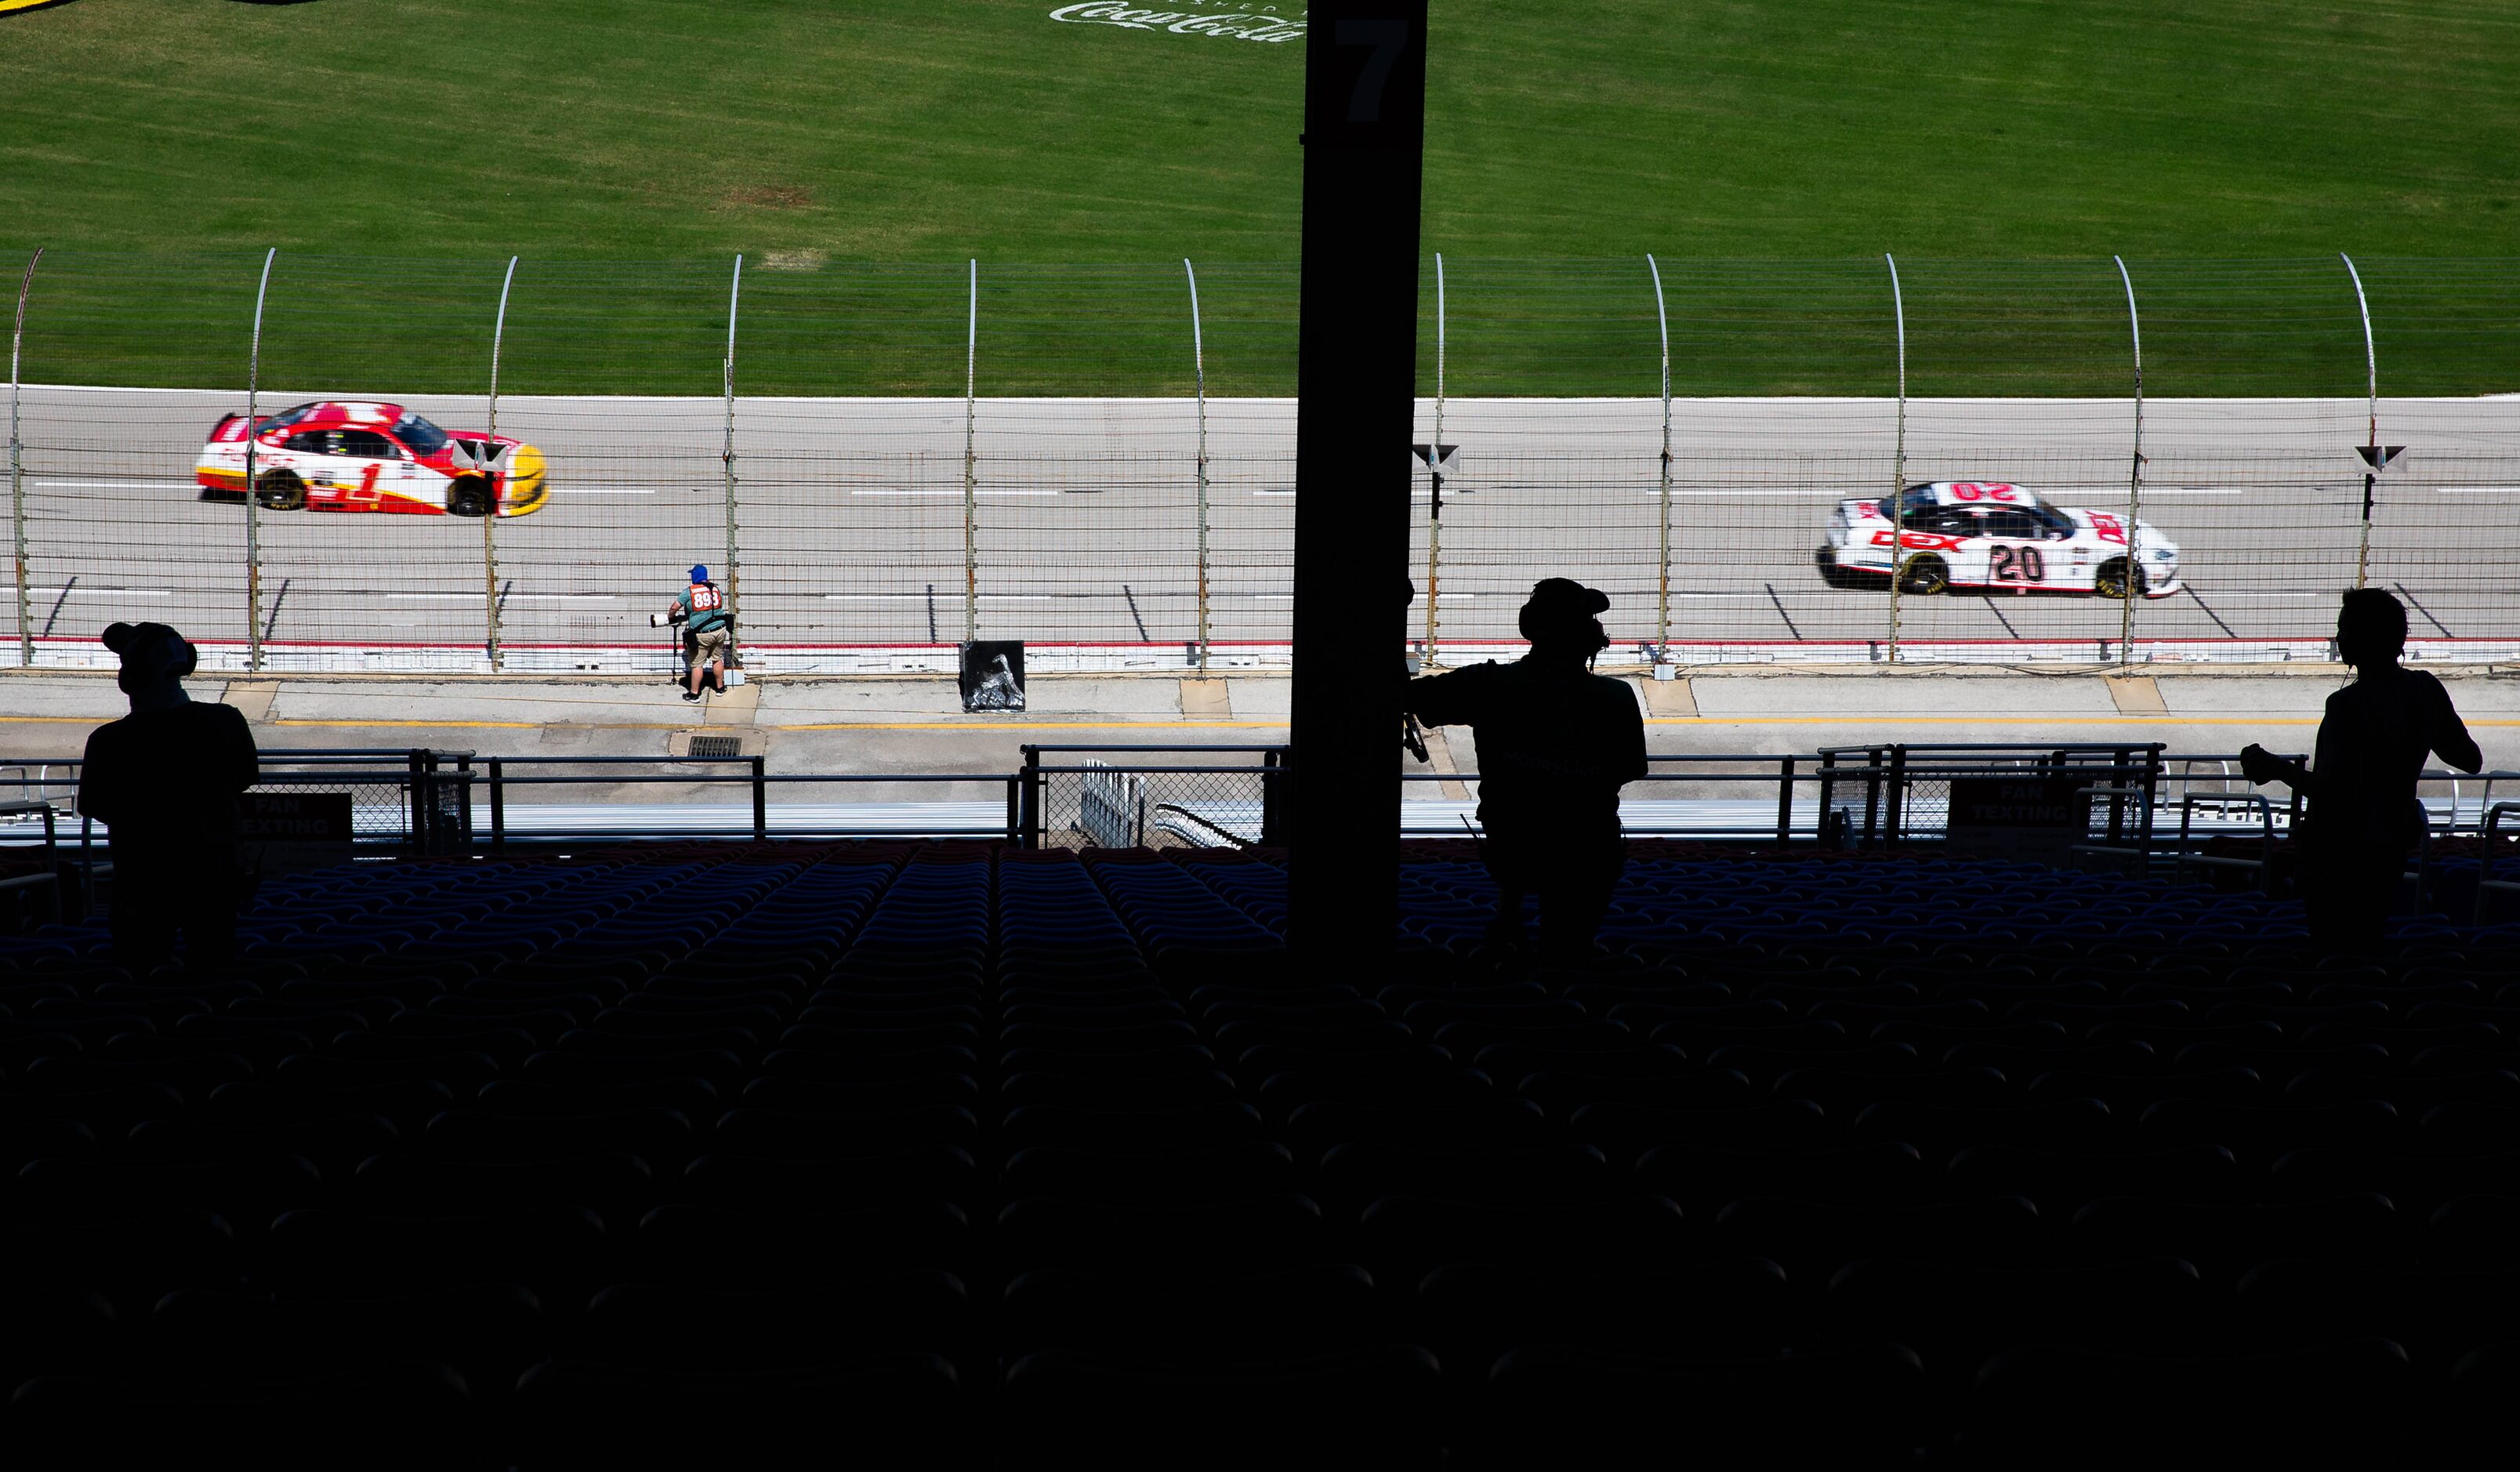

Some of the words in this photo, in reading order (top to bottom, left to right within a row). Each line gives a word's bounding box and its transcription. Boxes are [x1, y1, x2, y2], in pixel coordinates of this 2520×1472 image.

[1334, 19, 1410, 124] 7
[347, 463, 383, 501] 1
[1870, 530, 1971, 553] DEX
[1990, 544, 2043, 582] 20
[2001, 785, 2043, 800] FAN
[254, 798, 301, 814] FAN
[1971, 804, 2068, 821] TEXTING
[240, 818, 329, 835] EXTING
